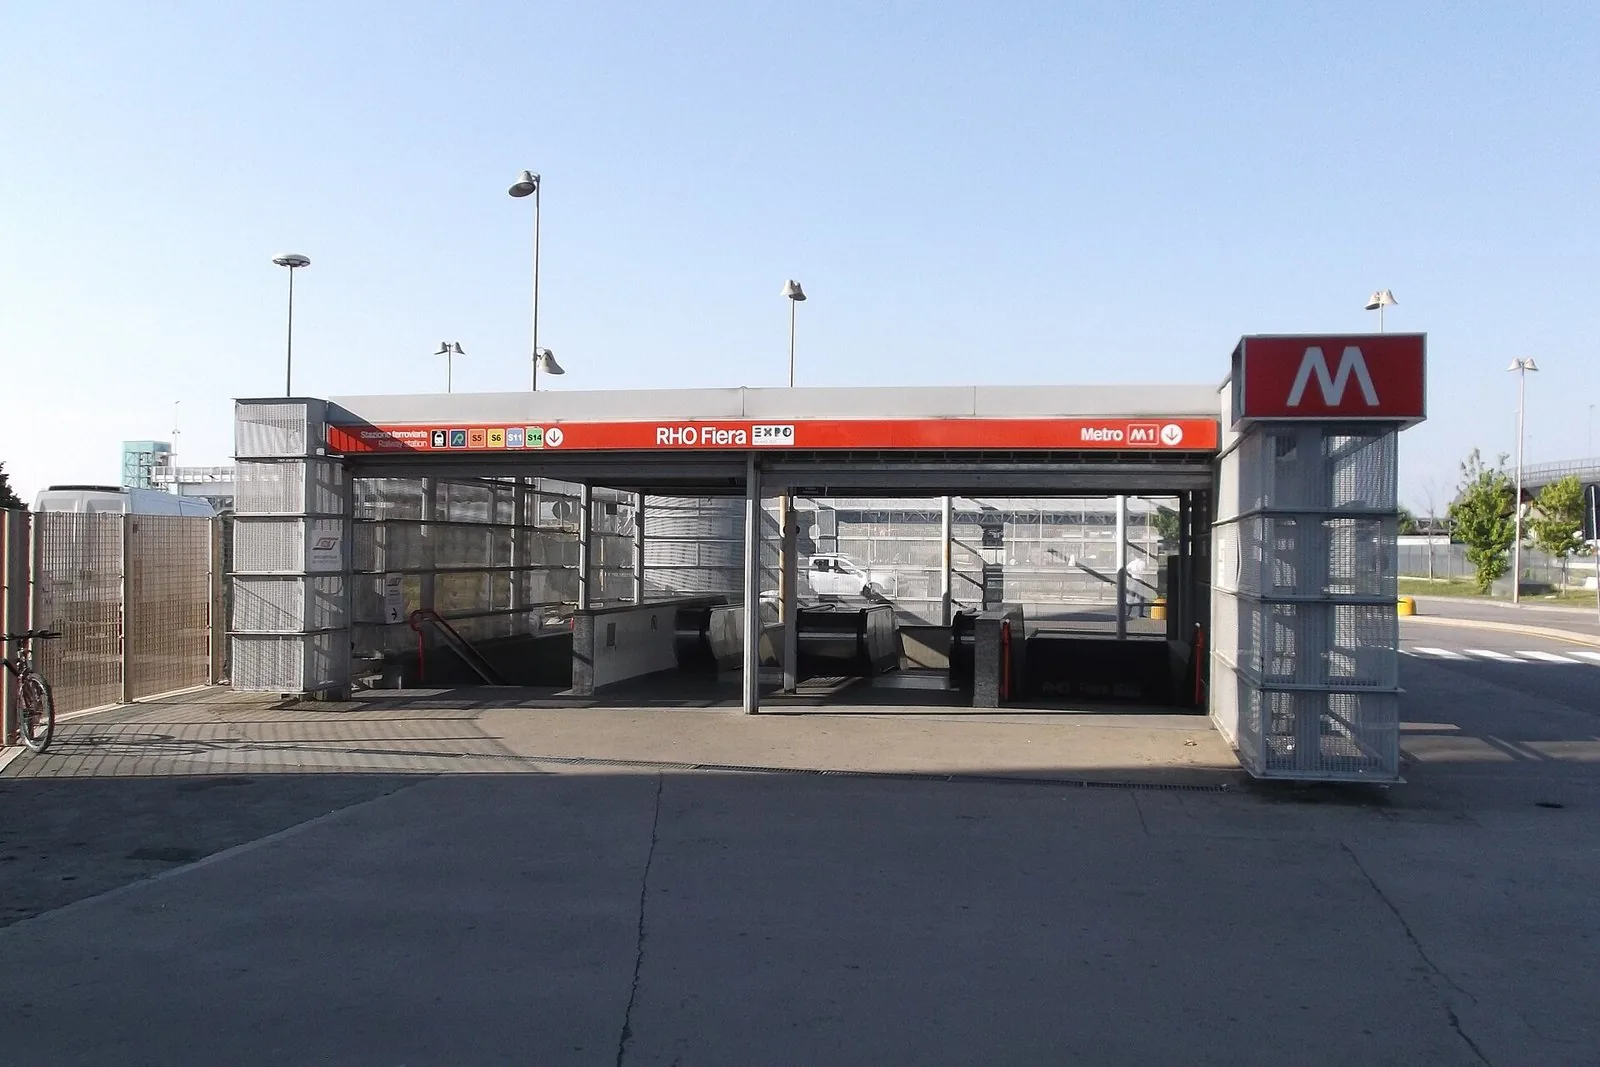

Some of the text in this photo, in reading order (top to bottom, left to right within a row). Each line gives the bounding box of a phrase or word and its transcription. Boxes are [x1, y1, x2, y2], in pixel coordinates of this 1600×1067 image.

[1286, 346, 1380, 406] M
[360, 430, 428, 439] Stazione ferroviaria
[656, 427, 747, 445] RHO Fiera
[755, 427, 792, 437] EXPO
[1081, 427, 1154, 441] Metro M1
[472, 434, 482, 442] S5
[491, 434, 501, 442] S6
[508, 434, 522, 442] S11
[528, 434, 542, 442] S14
[378, 440, 428, 448] Railway station
